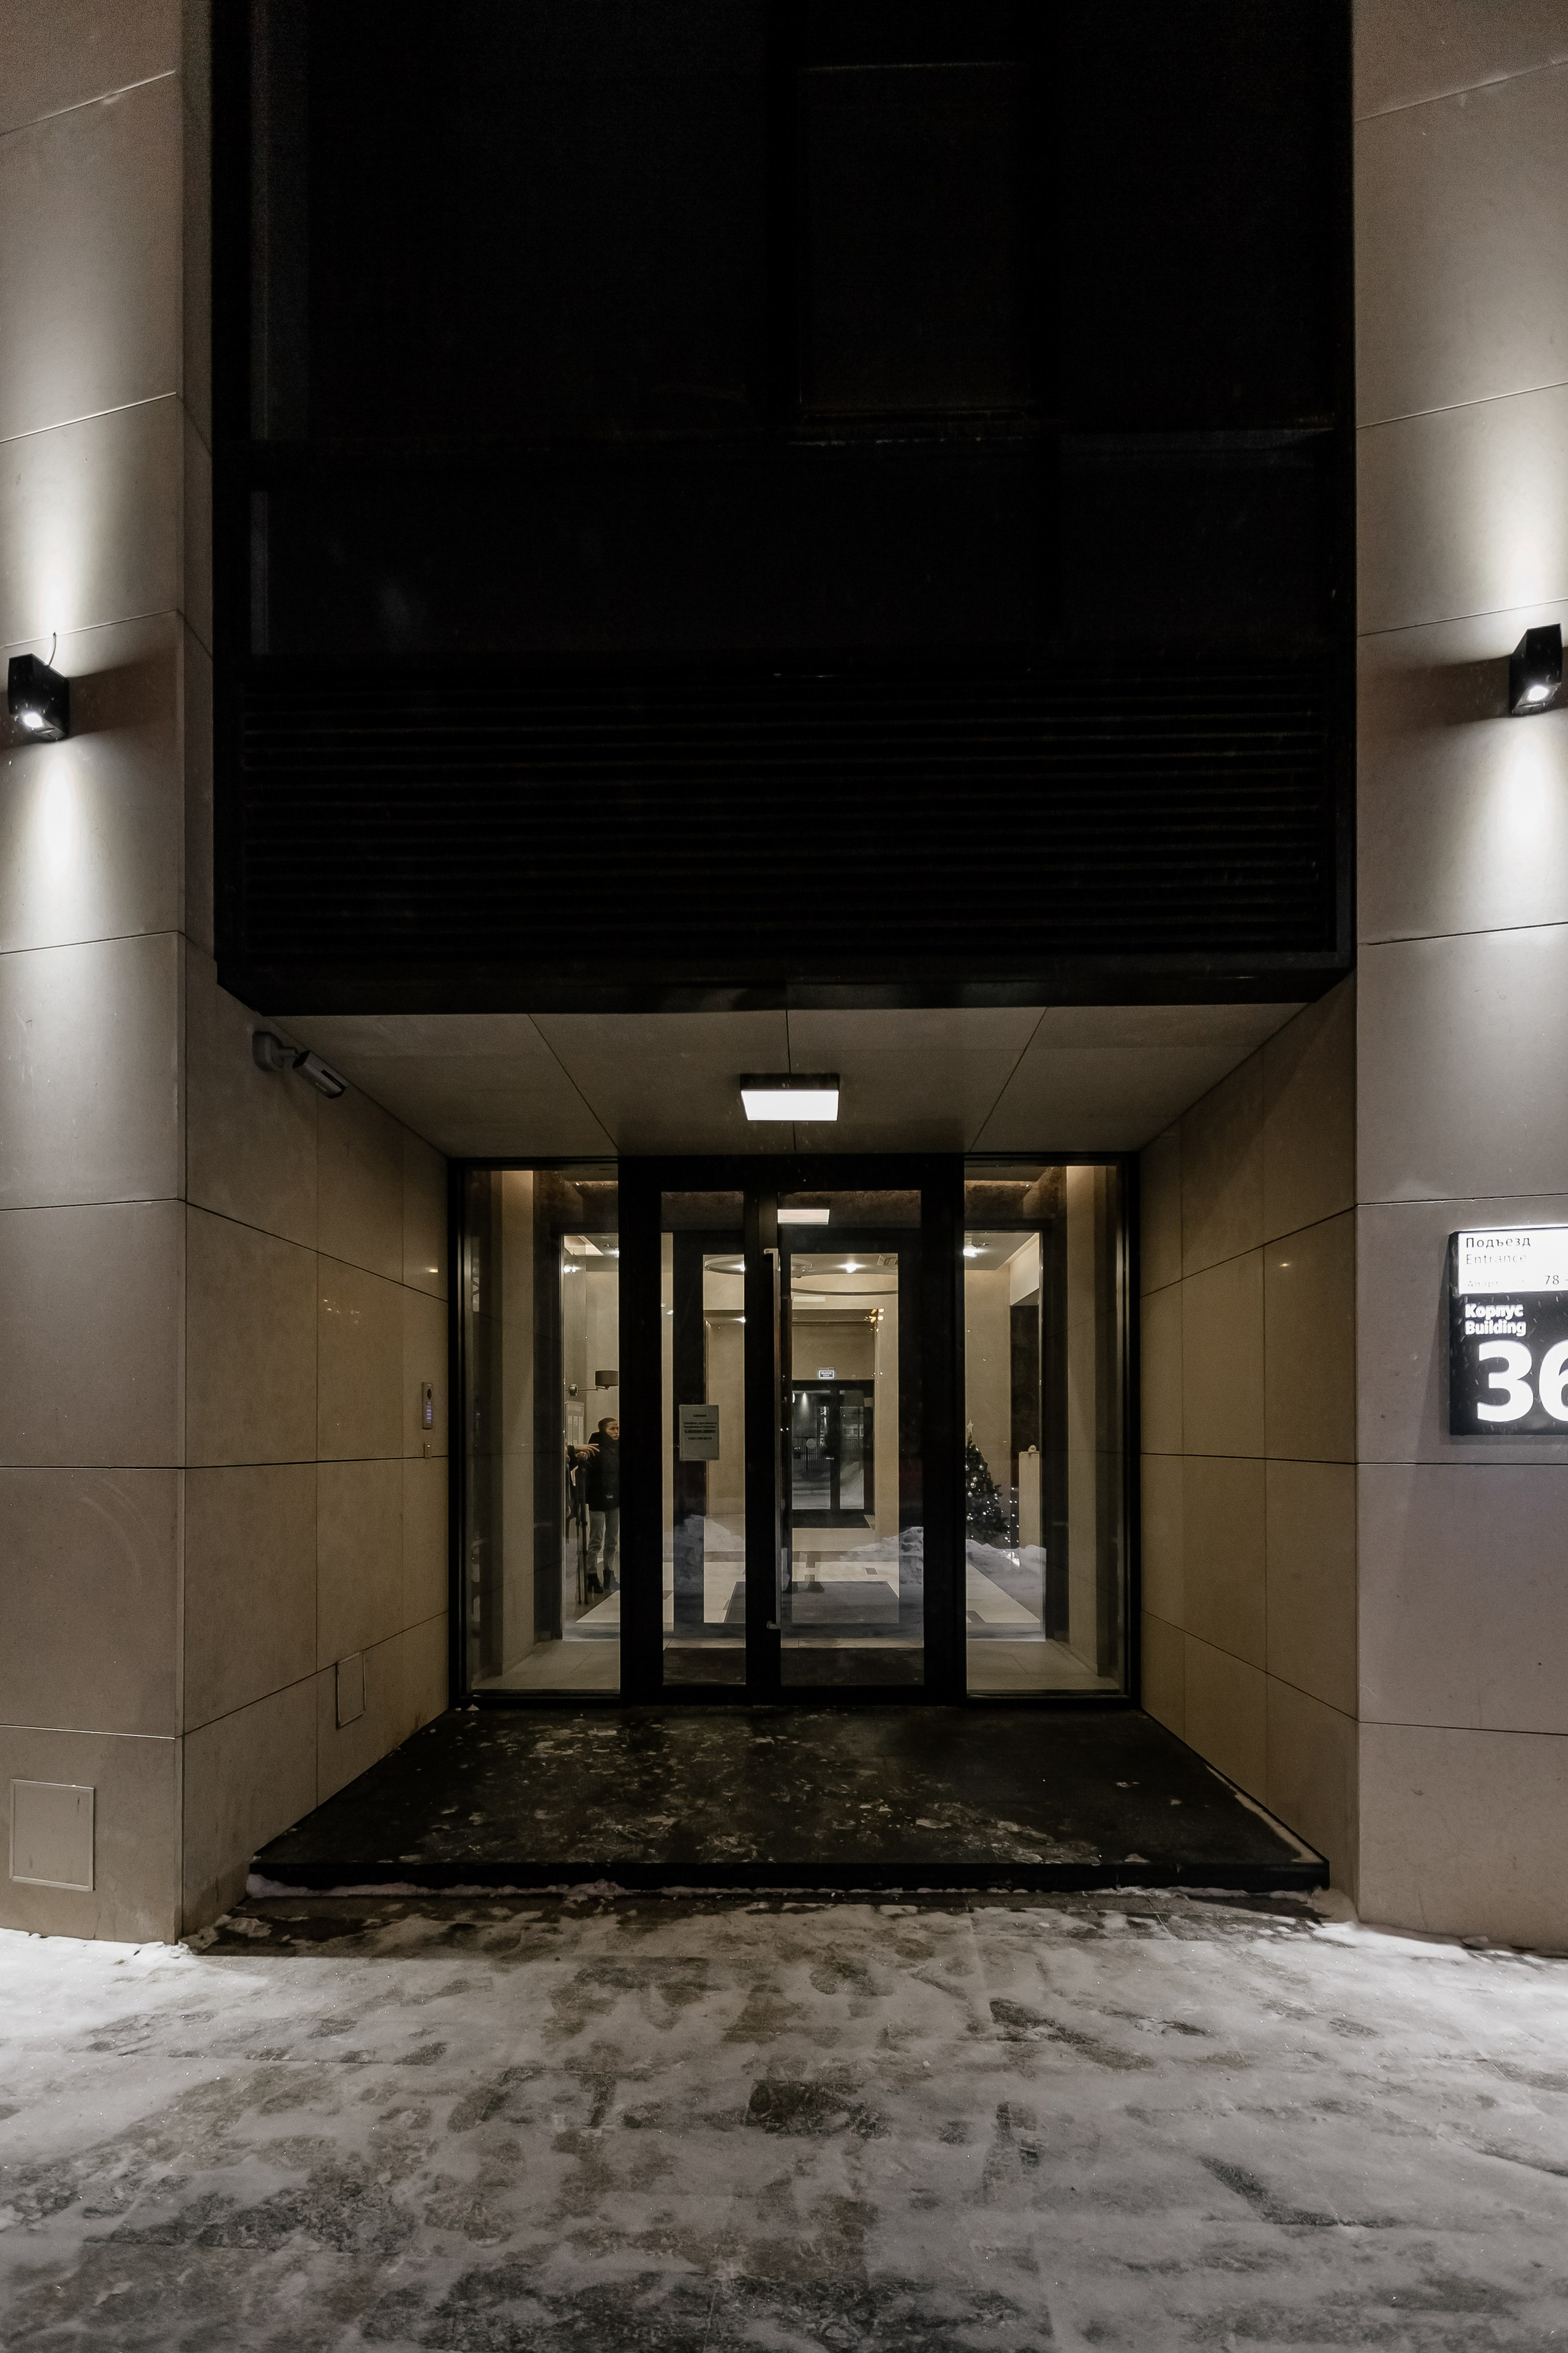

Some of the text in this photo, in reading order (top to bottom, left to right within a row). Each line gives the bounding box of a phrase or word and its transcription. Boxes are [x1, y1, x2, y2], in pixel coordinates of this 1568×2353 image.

[1466, 1237, 1531, 1249] Подъезд
[1466, 1253, 1526, 1264] Entrance
[1545, 1275, 1559, 1285] 78
[1464, 1304, 1524, 1320] Корпус
[1464, 1319, 1526, 1337] Building
